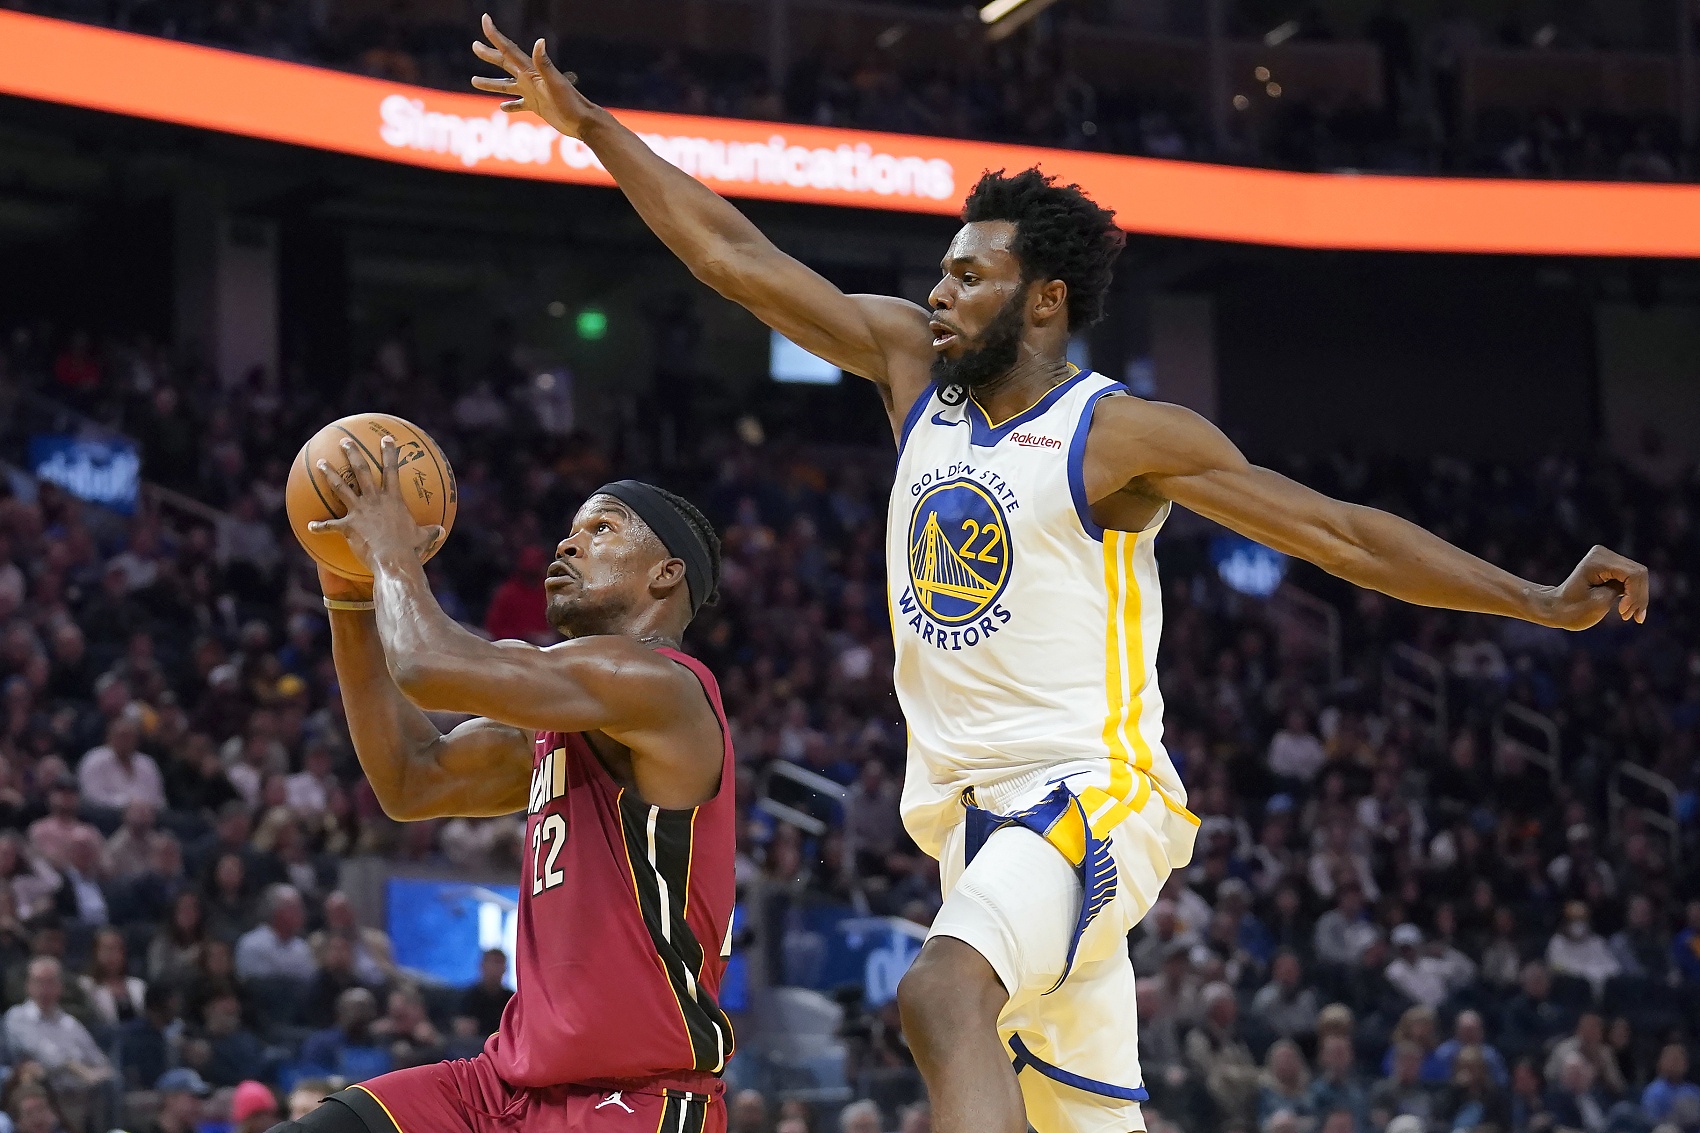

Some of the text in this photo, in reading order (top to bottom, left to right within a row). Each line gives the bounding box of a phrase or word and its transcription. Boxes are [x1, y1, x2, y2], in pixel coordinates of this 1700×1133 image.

[380, 95, 954, 199] Simpler cmunications
[941, 384, 963, 403] 6
[1009, 431, 1062, 450] Rakuten
[979, 470, 1019, 513] STATE
[958, 518, 1001, 563] 22
[899, 585, 1012, 651] WARRIORS
[531, 812, 567, 898] 22
